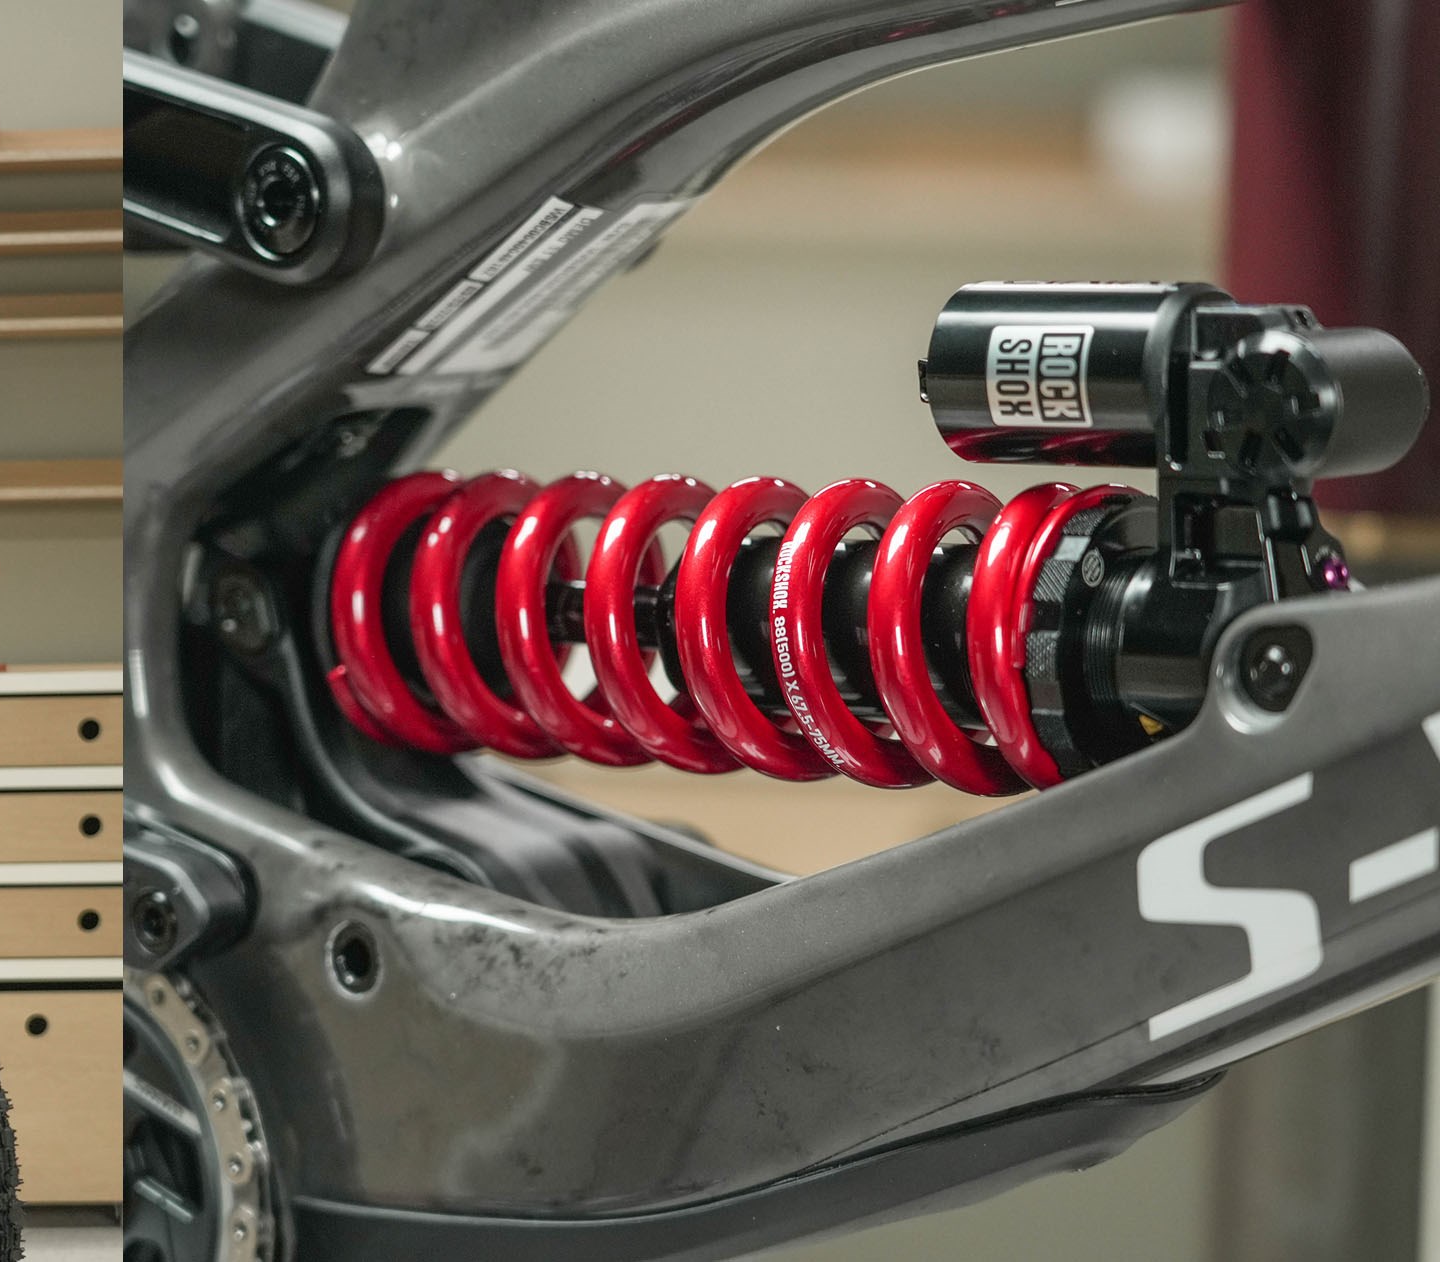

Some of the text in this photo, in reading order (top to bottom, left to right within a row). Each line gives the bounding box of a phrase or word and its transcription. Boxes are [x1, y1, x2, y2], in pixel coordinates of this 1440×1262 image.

[996, 339, 1033, 416] SHOX
[1040, 333, 1084, 425] ROCK
[785, 680, 800, 692] X
[1136, 709, 1440, 1042] S-
